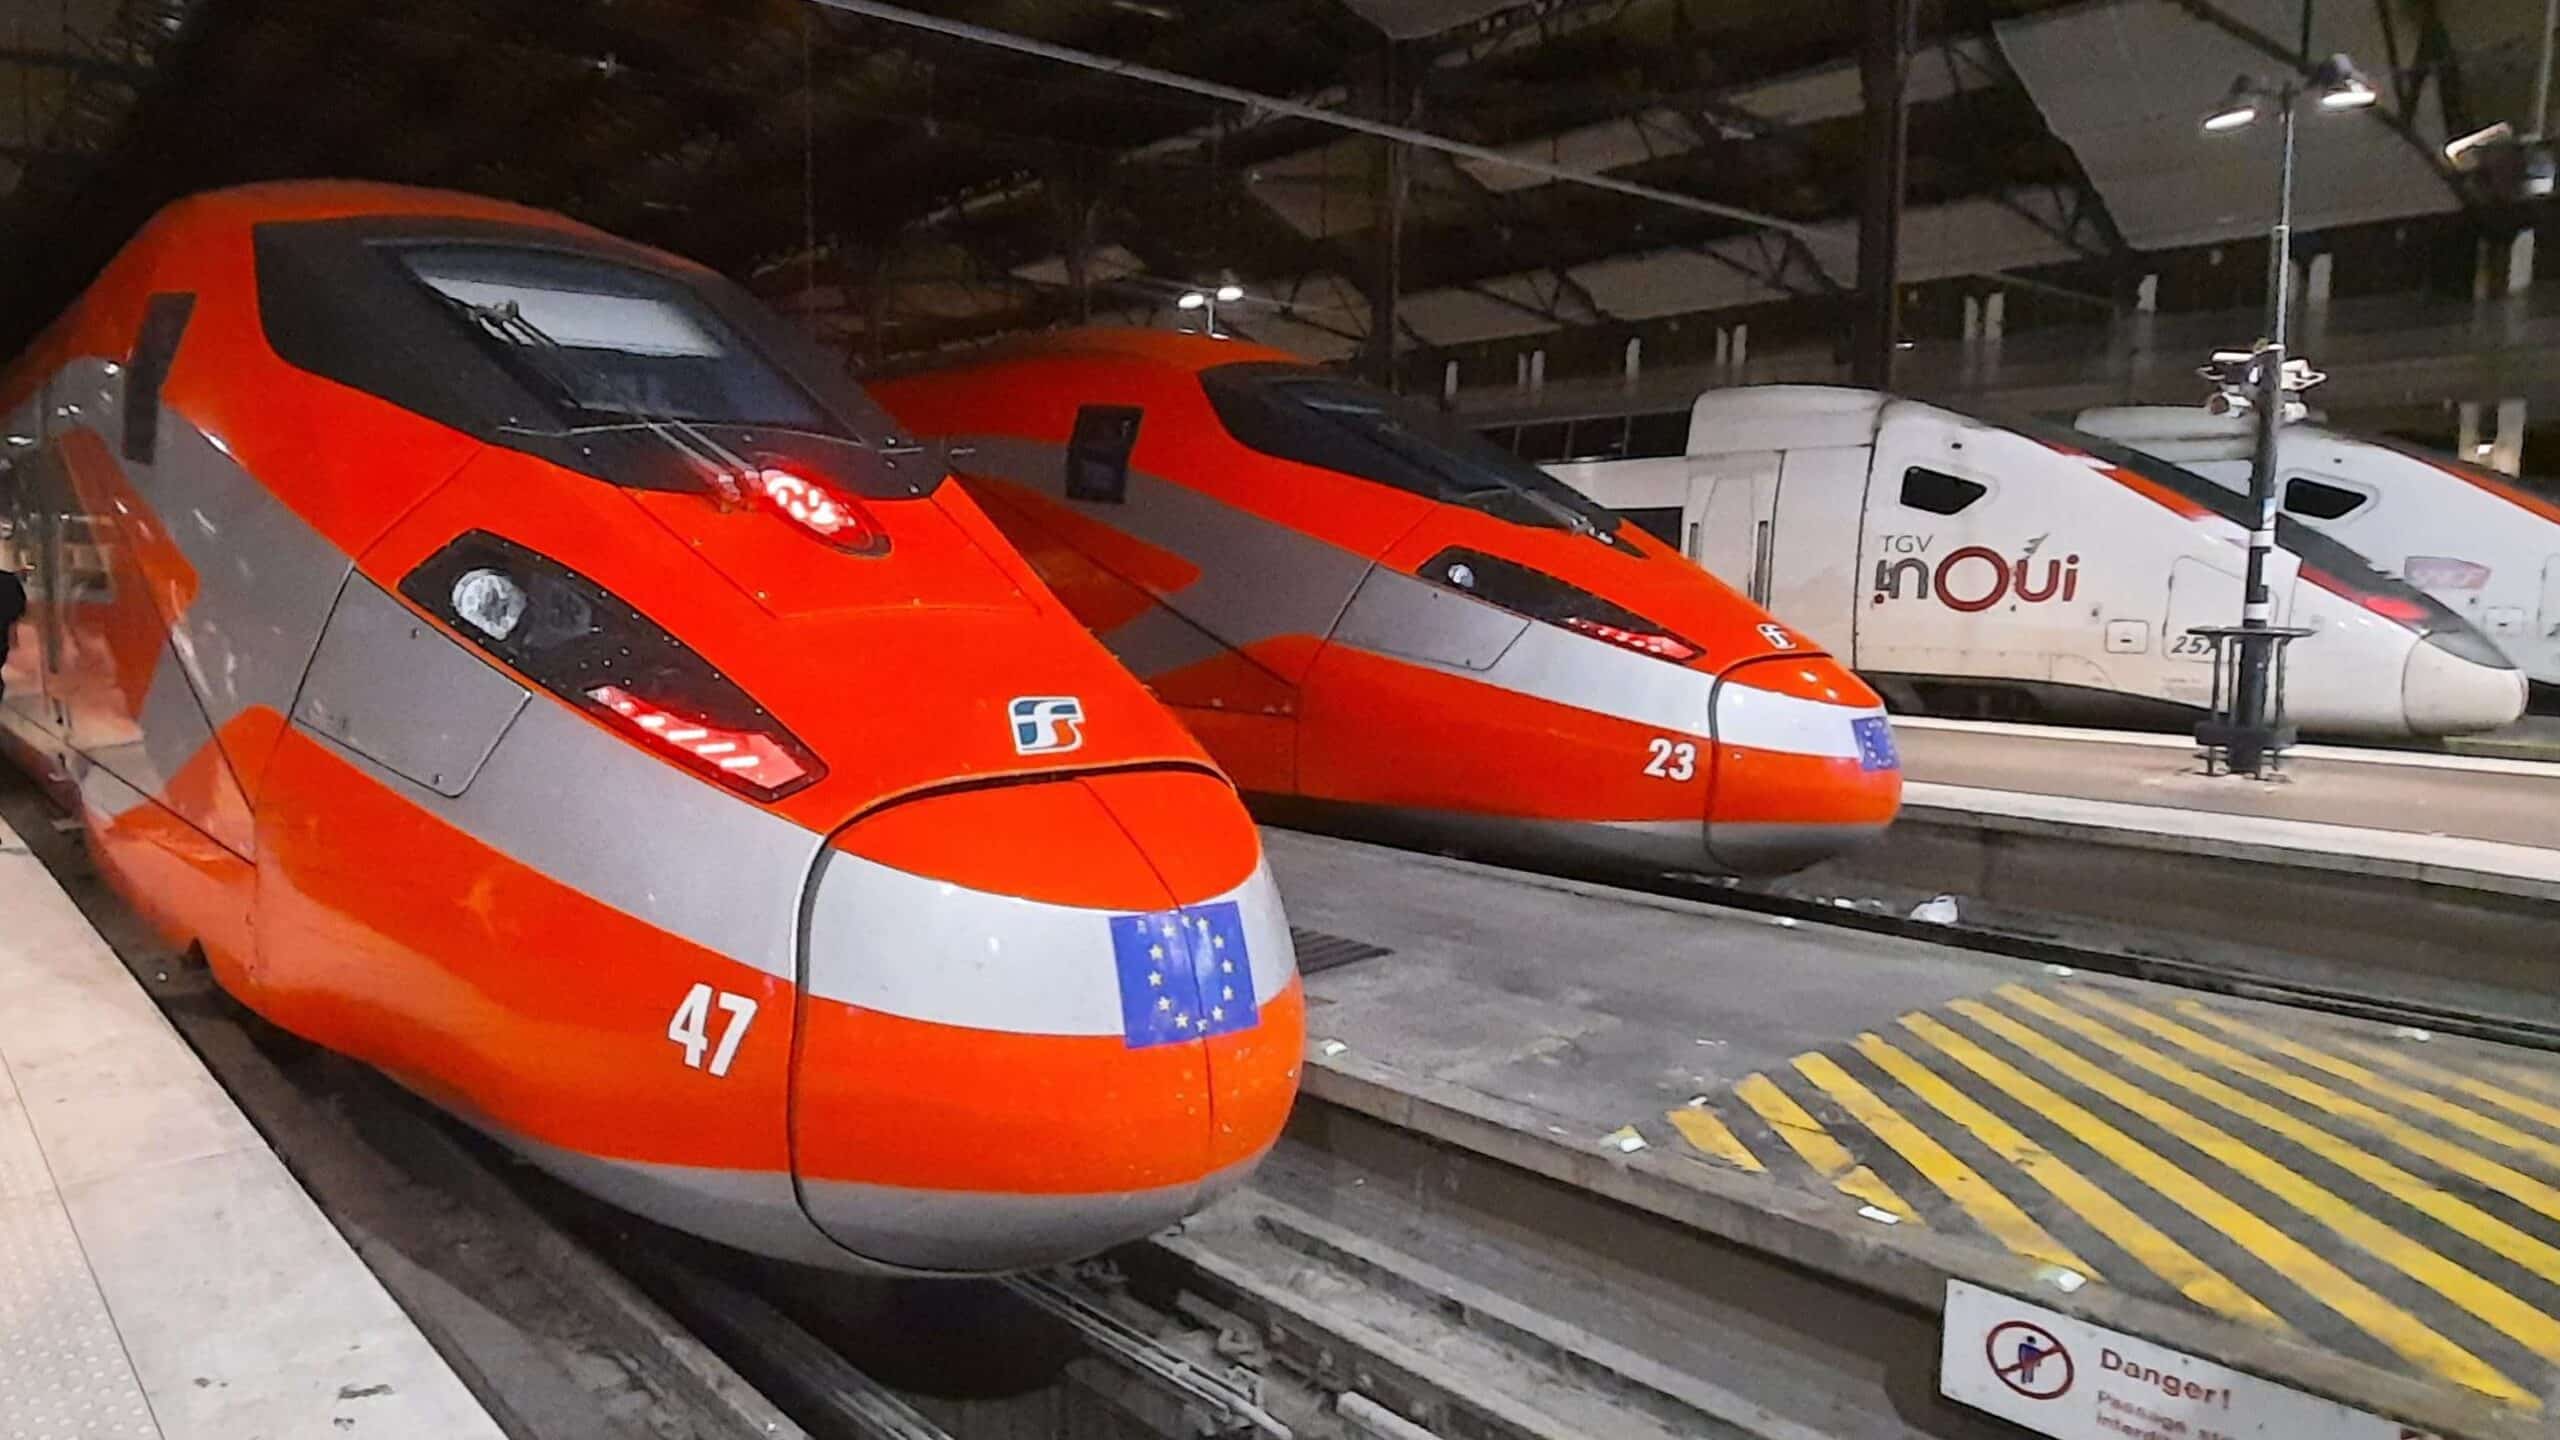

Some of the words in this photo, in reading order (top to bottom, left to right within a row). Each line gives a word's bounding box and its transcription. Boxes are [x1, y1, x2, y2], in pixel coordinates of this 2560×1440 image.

[1880, 534, 1933, 552] TGV
[1643, 738, 1696, 780] 23
[668, 982, 758, 1077] 47
[2101, 1348, 2231, 1409] Danger!
